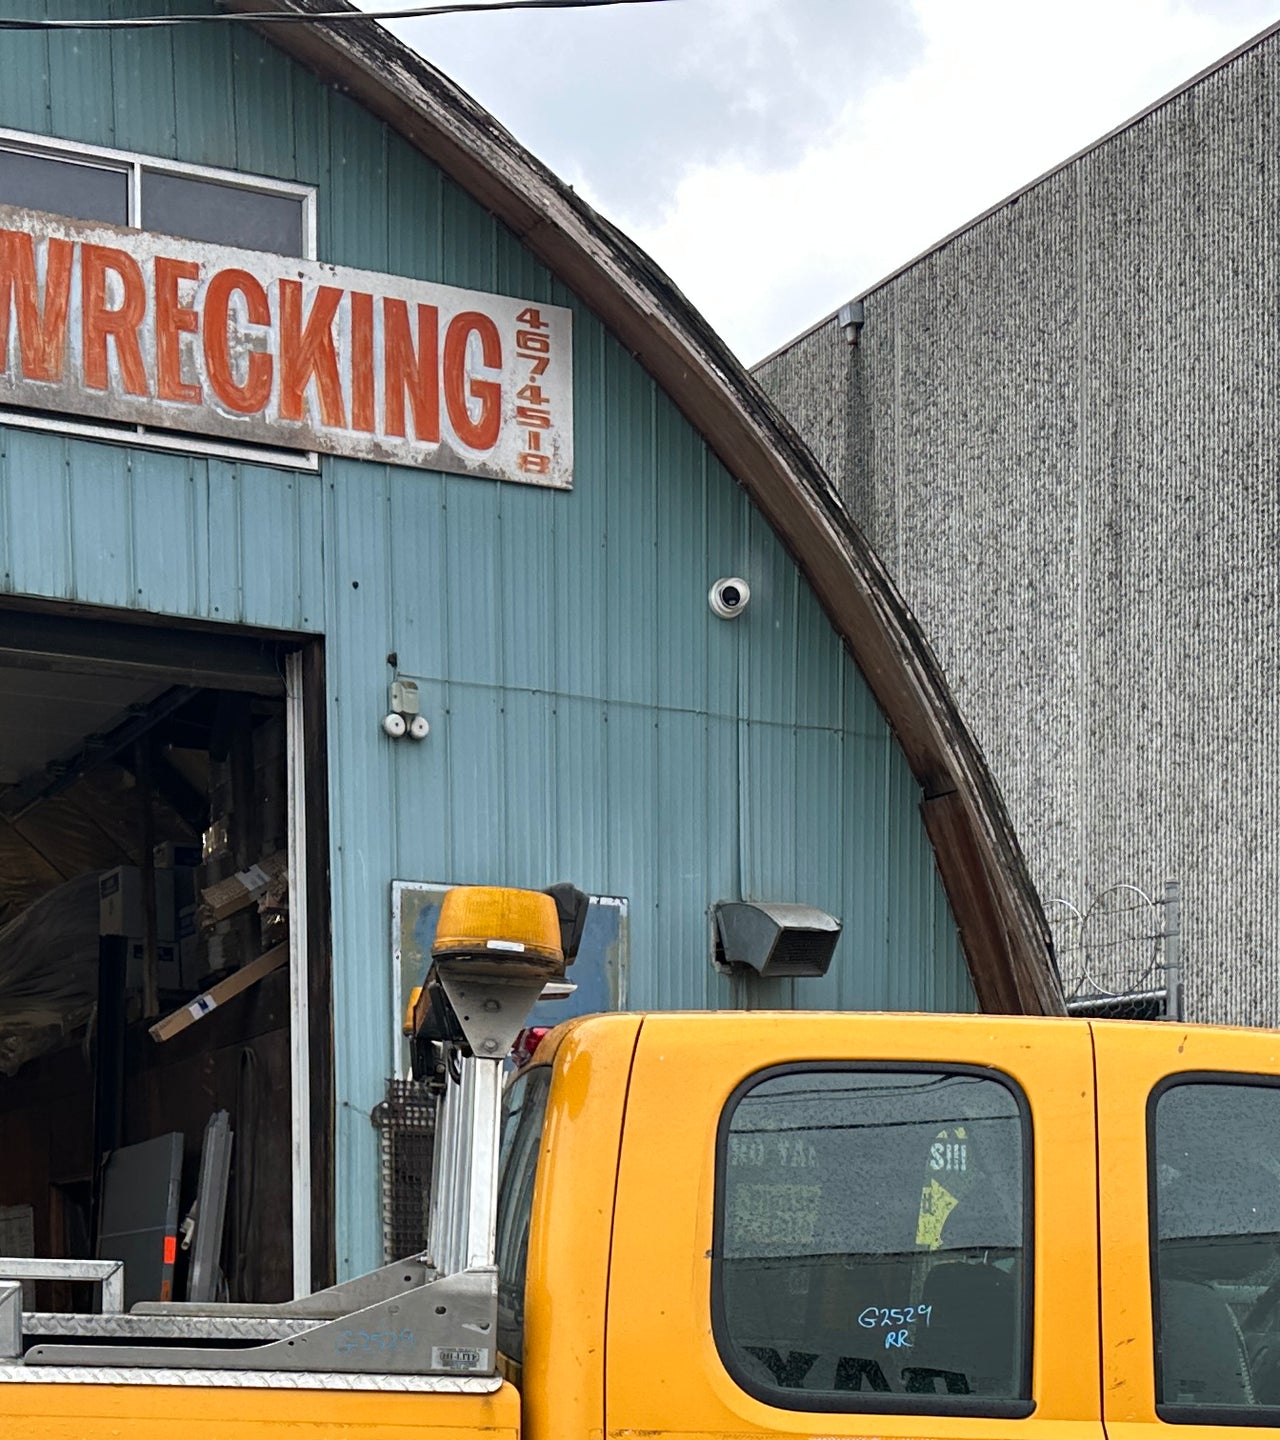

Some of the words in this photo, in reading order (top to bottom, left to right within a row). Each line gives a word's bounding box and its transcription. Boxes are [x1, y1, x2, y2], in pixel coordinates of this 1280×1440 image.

[857, 1304, 933, 1328] G2529
[335, 1327, 416, 1356] G2529
[885, 1329, 913, 1349] RR
